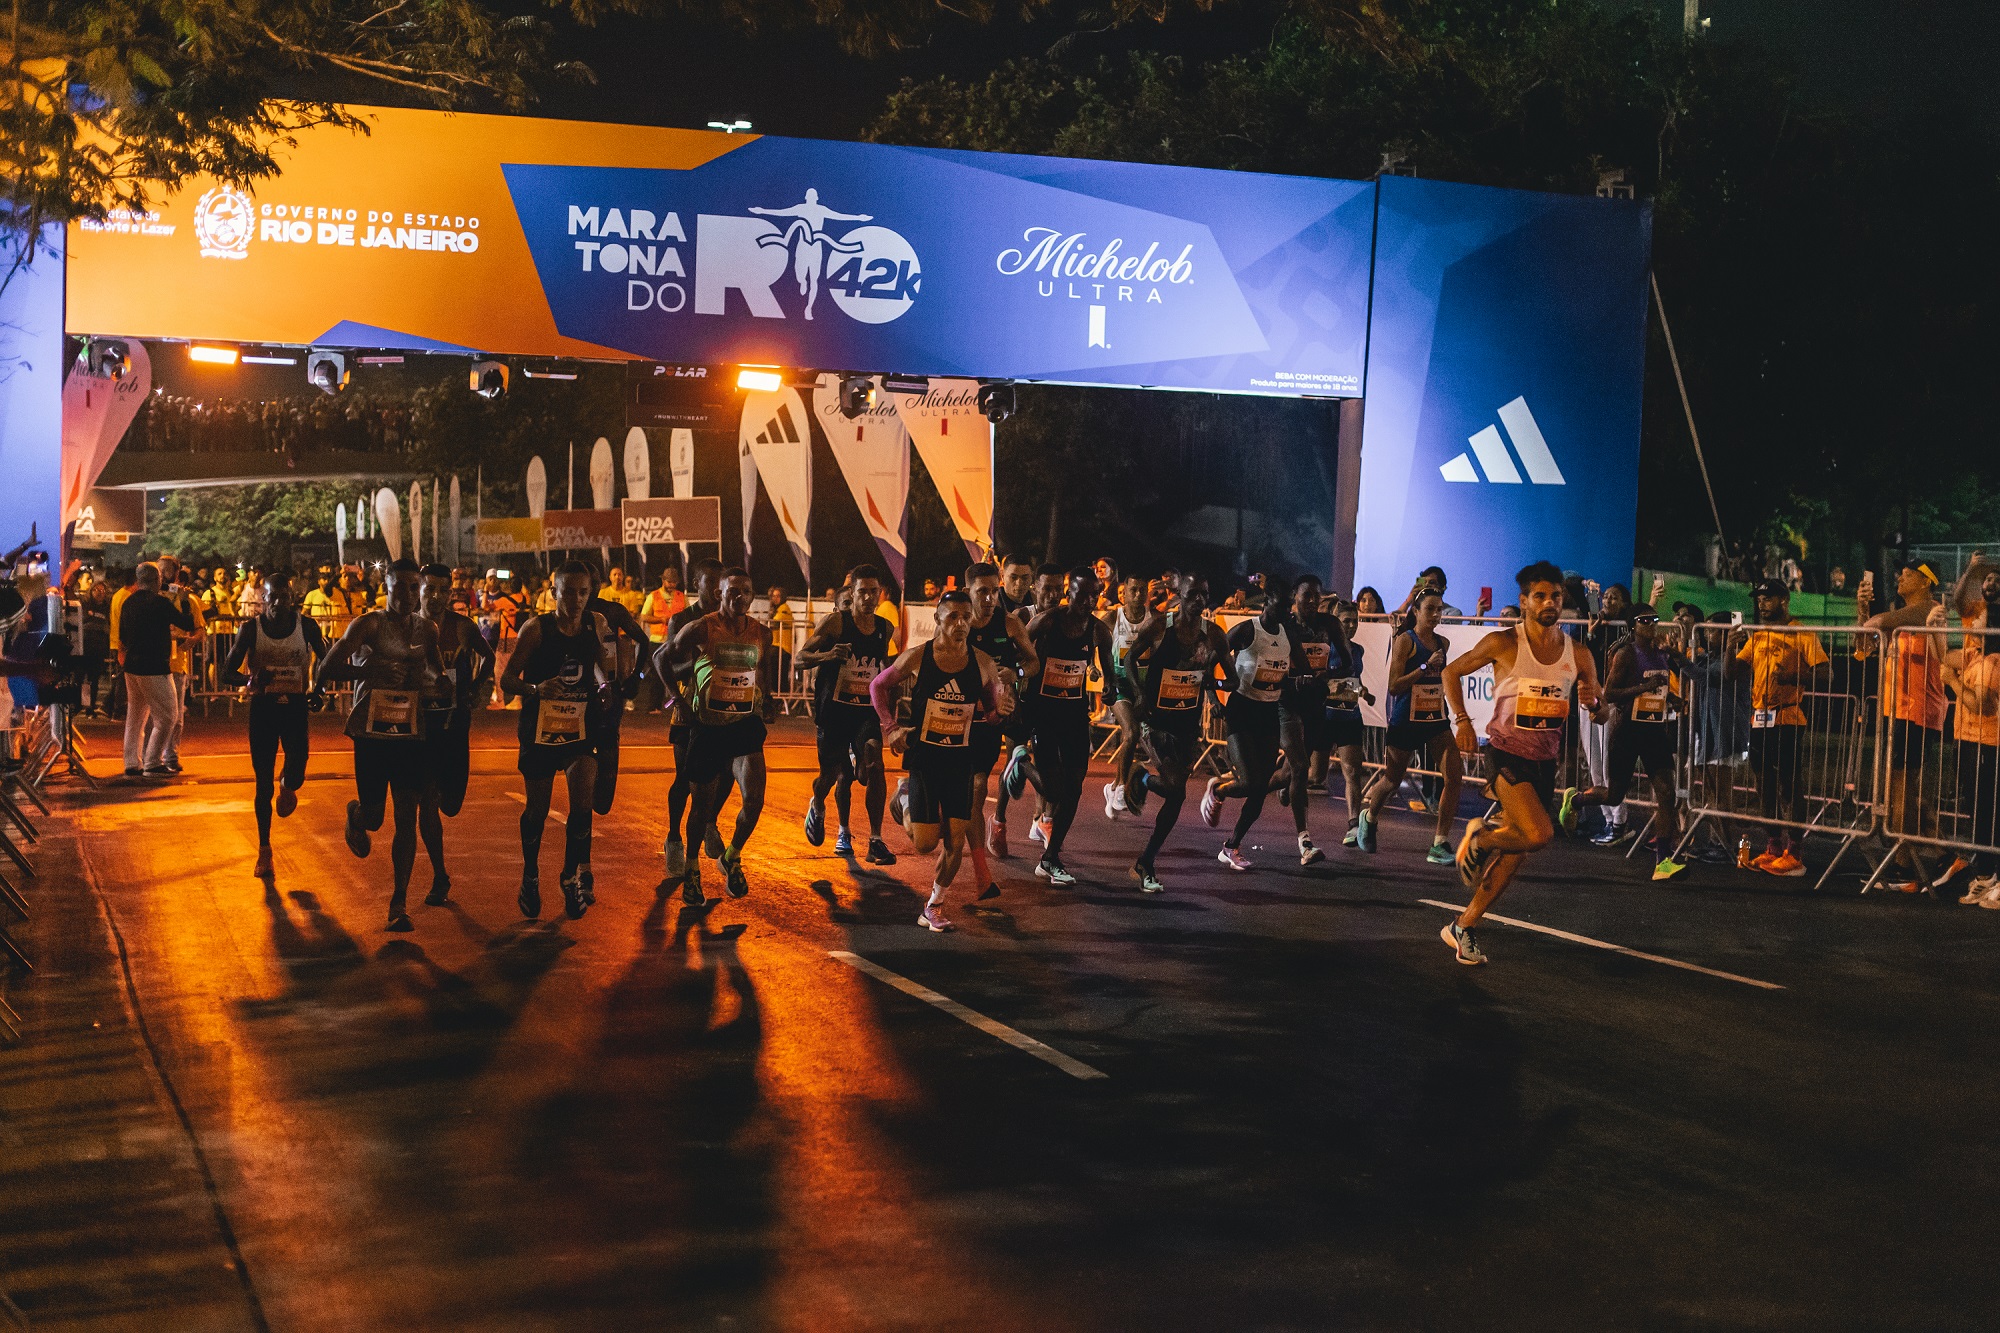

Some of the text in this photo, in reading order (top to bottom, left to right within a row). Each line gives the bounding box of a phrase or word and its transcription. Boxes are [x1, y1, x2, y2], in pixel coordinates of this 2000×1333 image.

[261, 203, 480, 229] GOVERNO DO ESTADO
[131, 222, 140, 234] e
[142, 223, 177, 236] Lazer
[568, 205, 687, 242] MARA
[260, 219, 480, 254] RIO DE JANEIRO
[575, 241, 687, 278] TONA
[996, 226, 1194, 284] Michelob
[627, 279, 687, 313] DO
[1038, 280, 1163, 304] ULTRA
[653, 365, 708, 378] POLAR
[1275, 372, 1358, 384] BEBA COM MODERAÇÃO
[1250, 379, 1278, 387] Produto
[1295, 382, 1322, 390] maiores
[1322, 382, 1332, 390] de
[921, 408, 970, 417] ULTRA
[625, 516, 674, 530] ONDA
[545, 526, 586, 539] ONDA
[625, 529, 674, 542] CINZA
[546, 535, 613, 549] LARANJA
[721, 689, 746, 701] GOMES
[934, 692, 966, 702] adidas
[931, 720, 964, 732] DOS SANTOS
